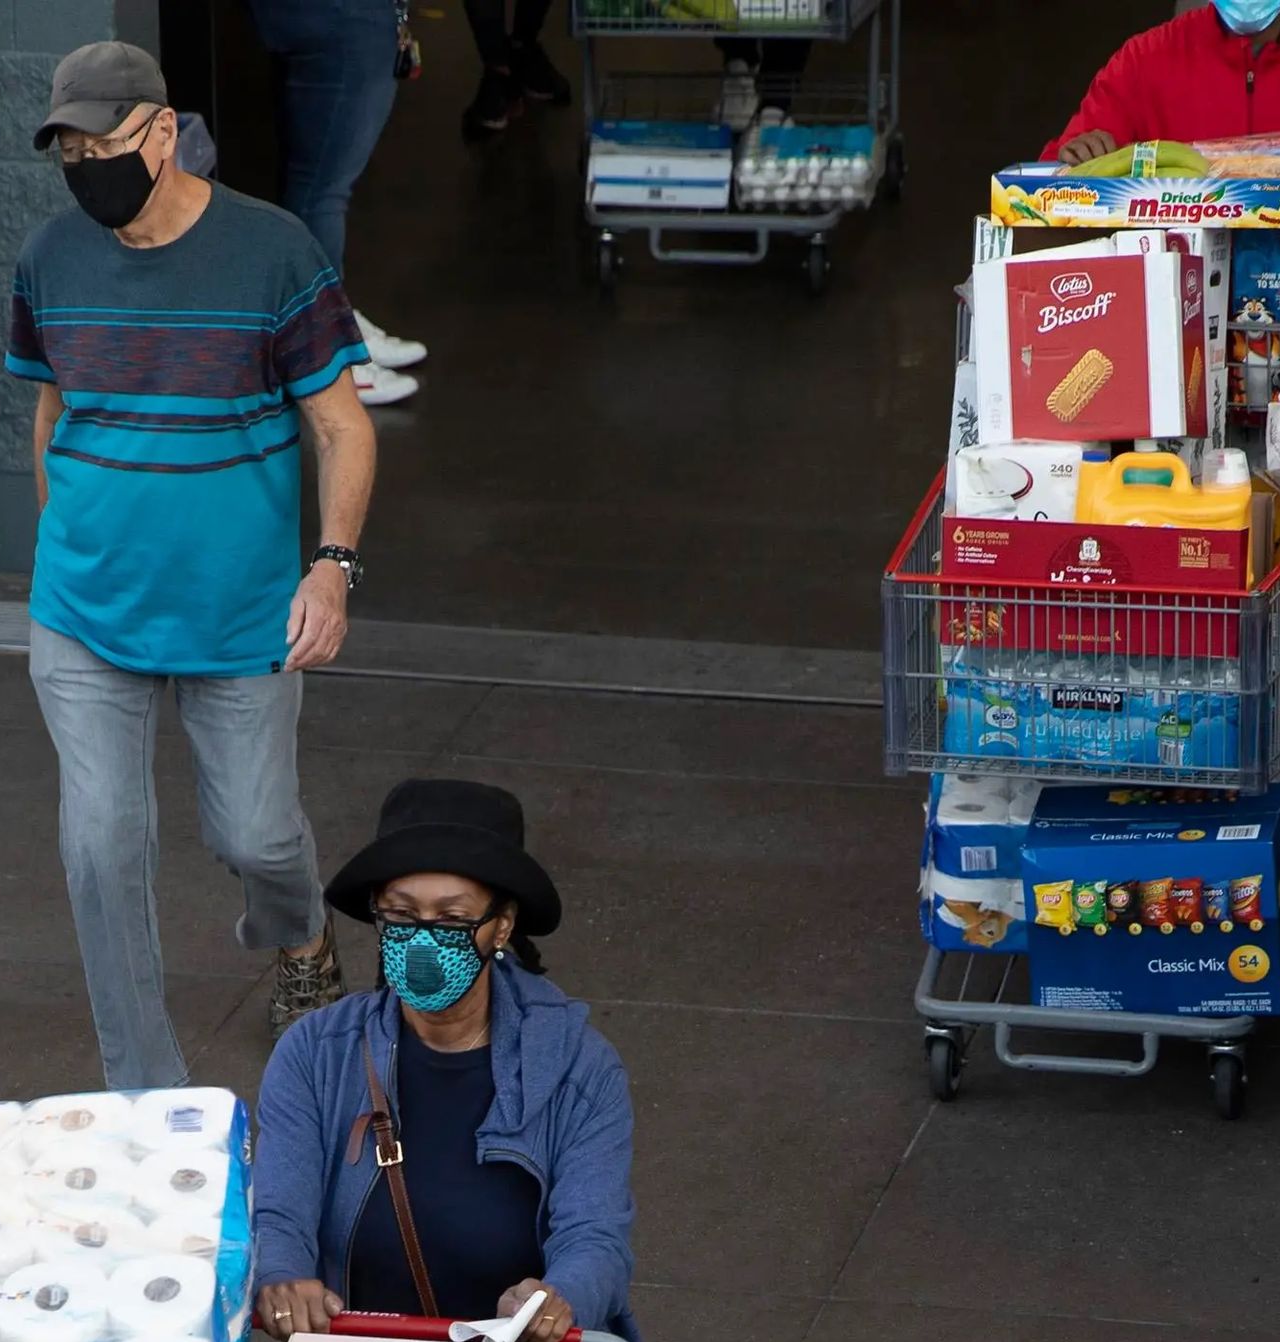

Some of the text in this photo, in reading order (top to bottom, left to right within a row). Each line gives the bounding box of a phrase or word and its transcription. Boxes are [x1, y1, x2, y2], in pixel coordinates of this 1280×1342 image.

[1162, 191, 1202, 204] Dried
[1057, 276, 1088, 294] Lotus
[1038, 292, 1112, 333] Biscoff
[1050, 464, 1072, 473] 240
[952, 525, 1010, 544] 6 YEARS GROWN
[1181, 543, 1202, 556] No.1
[1057, 691, 1120, 704] KIRKLAND
[1090, 830, 1174, 842] Classic Mix
[1148, 955, 1258, 973] Classic Mix 54
